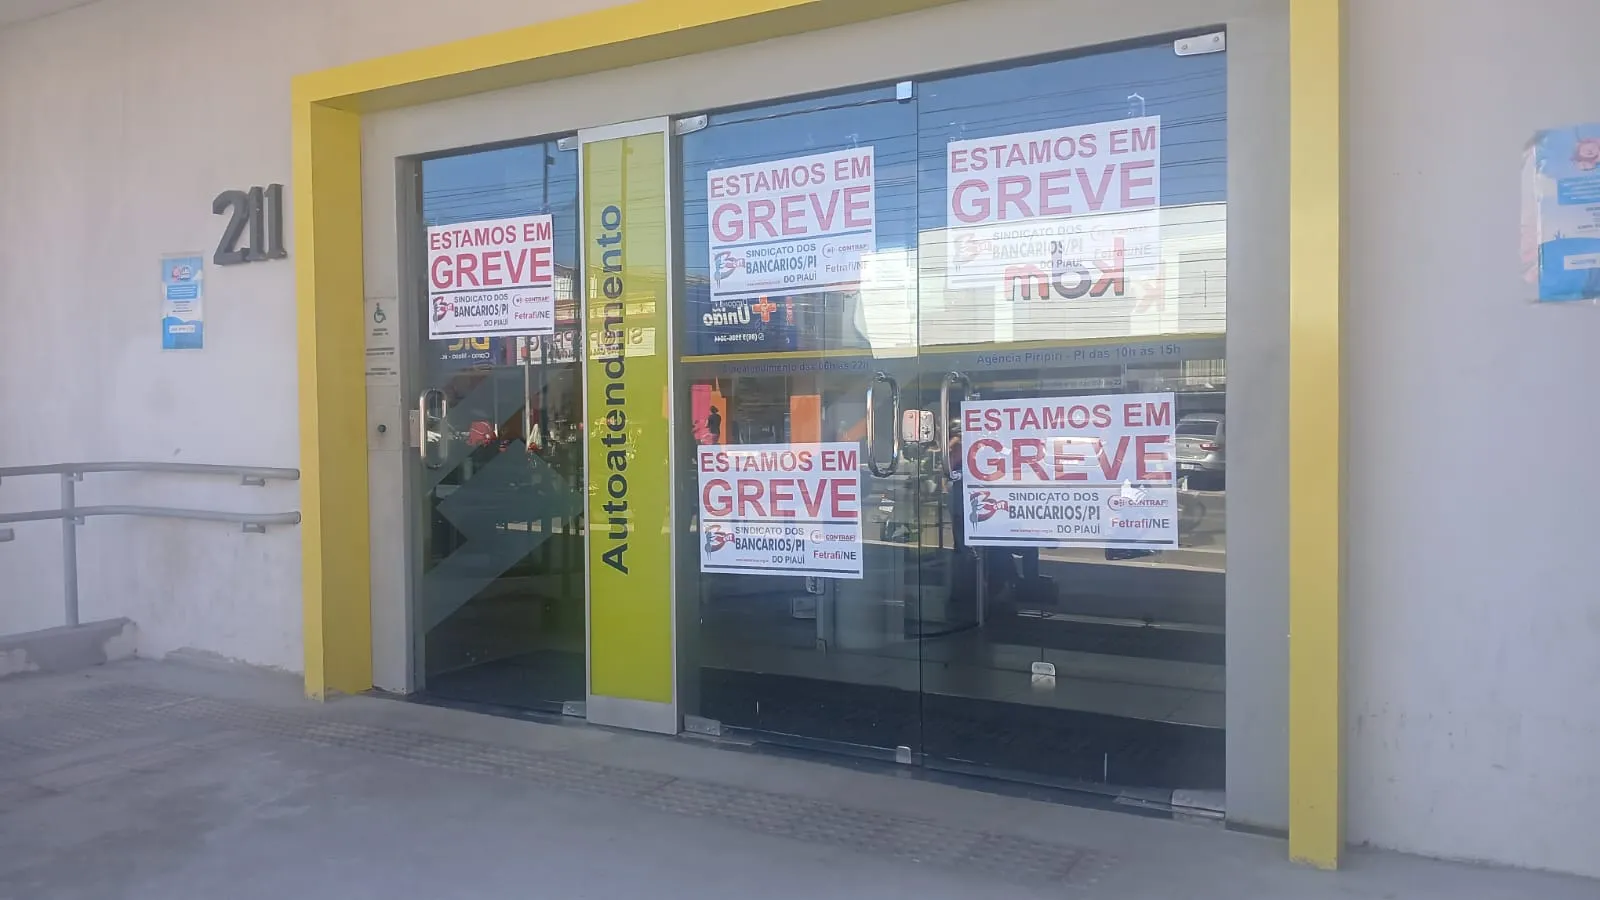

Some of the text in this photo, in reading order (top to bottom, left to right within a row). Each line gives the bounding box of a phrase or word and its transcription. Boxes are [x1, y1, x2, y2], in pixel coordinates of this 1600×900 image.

[951, 125, 1156, 173] ESTAMOS EM
[710, 155, 871, 198] ESTAMOS EM
[951, 159, 1156, 224] GREVE
[212, 183, 288, 266] 211
[711, 185, 872, 243] GREVE
[430, 222, 551, 250] ESTAMOS EM
[745, 243, 816, 258] SINDICATO DOS
[431, 246, 552, 289] GREVE
[783, 275, 796, 284] DO
[796, 272, 817, 282] PIAUÍ
[454, 294, 508, 303] SINDICATO DOS
[976, 352, 1021, 366] Agência
[1074, 350, 1085, 360] PI
[1088, 349, 1110, 359] das
[1116, 347, 1136, 358] 10h
[1160, 344, 1180, 354] 15h
[595, 204, 630, 575] Autoatendimento
[964, 401, 1171, 432] ESTAMOS EM
[700, 450, 857, 473] ESTAMOS EM
[966, 435, 1172, 482] GREVE
[702, 478, 858, 518] GREVE
[1008, 492, 1099, 502] SINDICATO DOS
[1009, 502, 1100, 520] BANCÁRIOS/PI
[736, 526, 804, 536] SINDICATO DOS
[1057, 524, 1072, 534] DO
[1074, 524, 1100, 534] PIAUÍ
[1111, 518, 1170, 529] Fetrafi/NE
[736, 536, 805, 552] BANCÁRIOS/PI
[772, 556, 783, 564] DO
[784, 554, 805, 565] PIAUÍ
[814, 551, 857, 561] Fetrafi/NE
